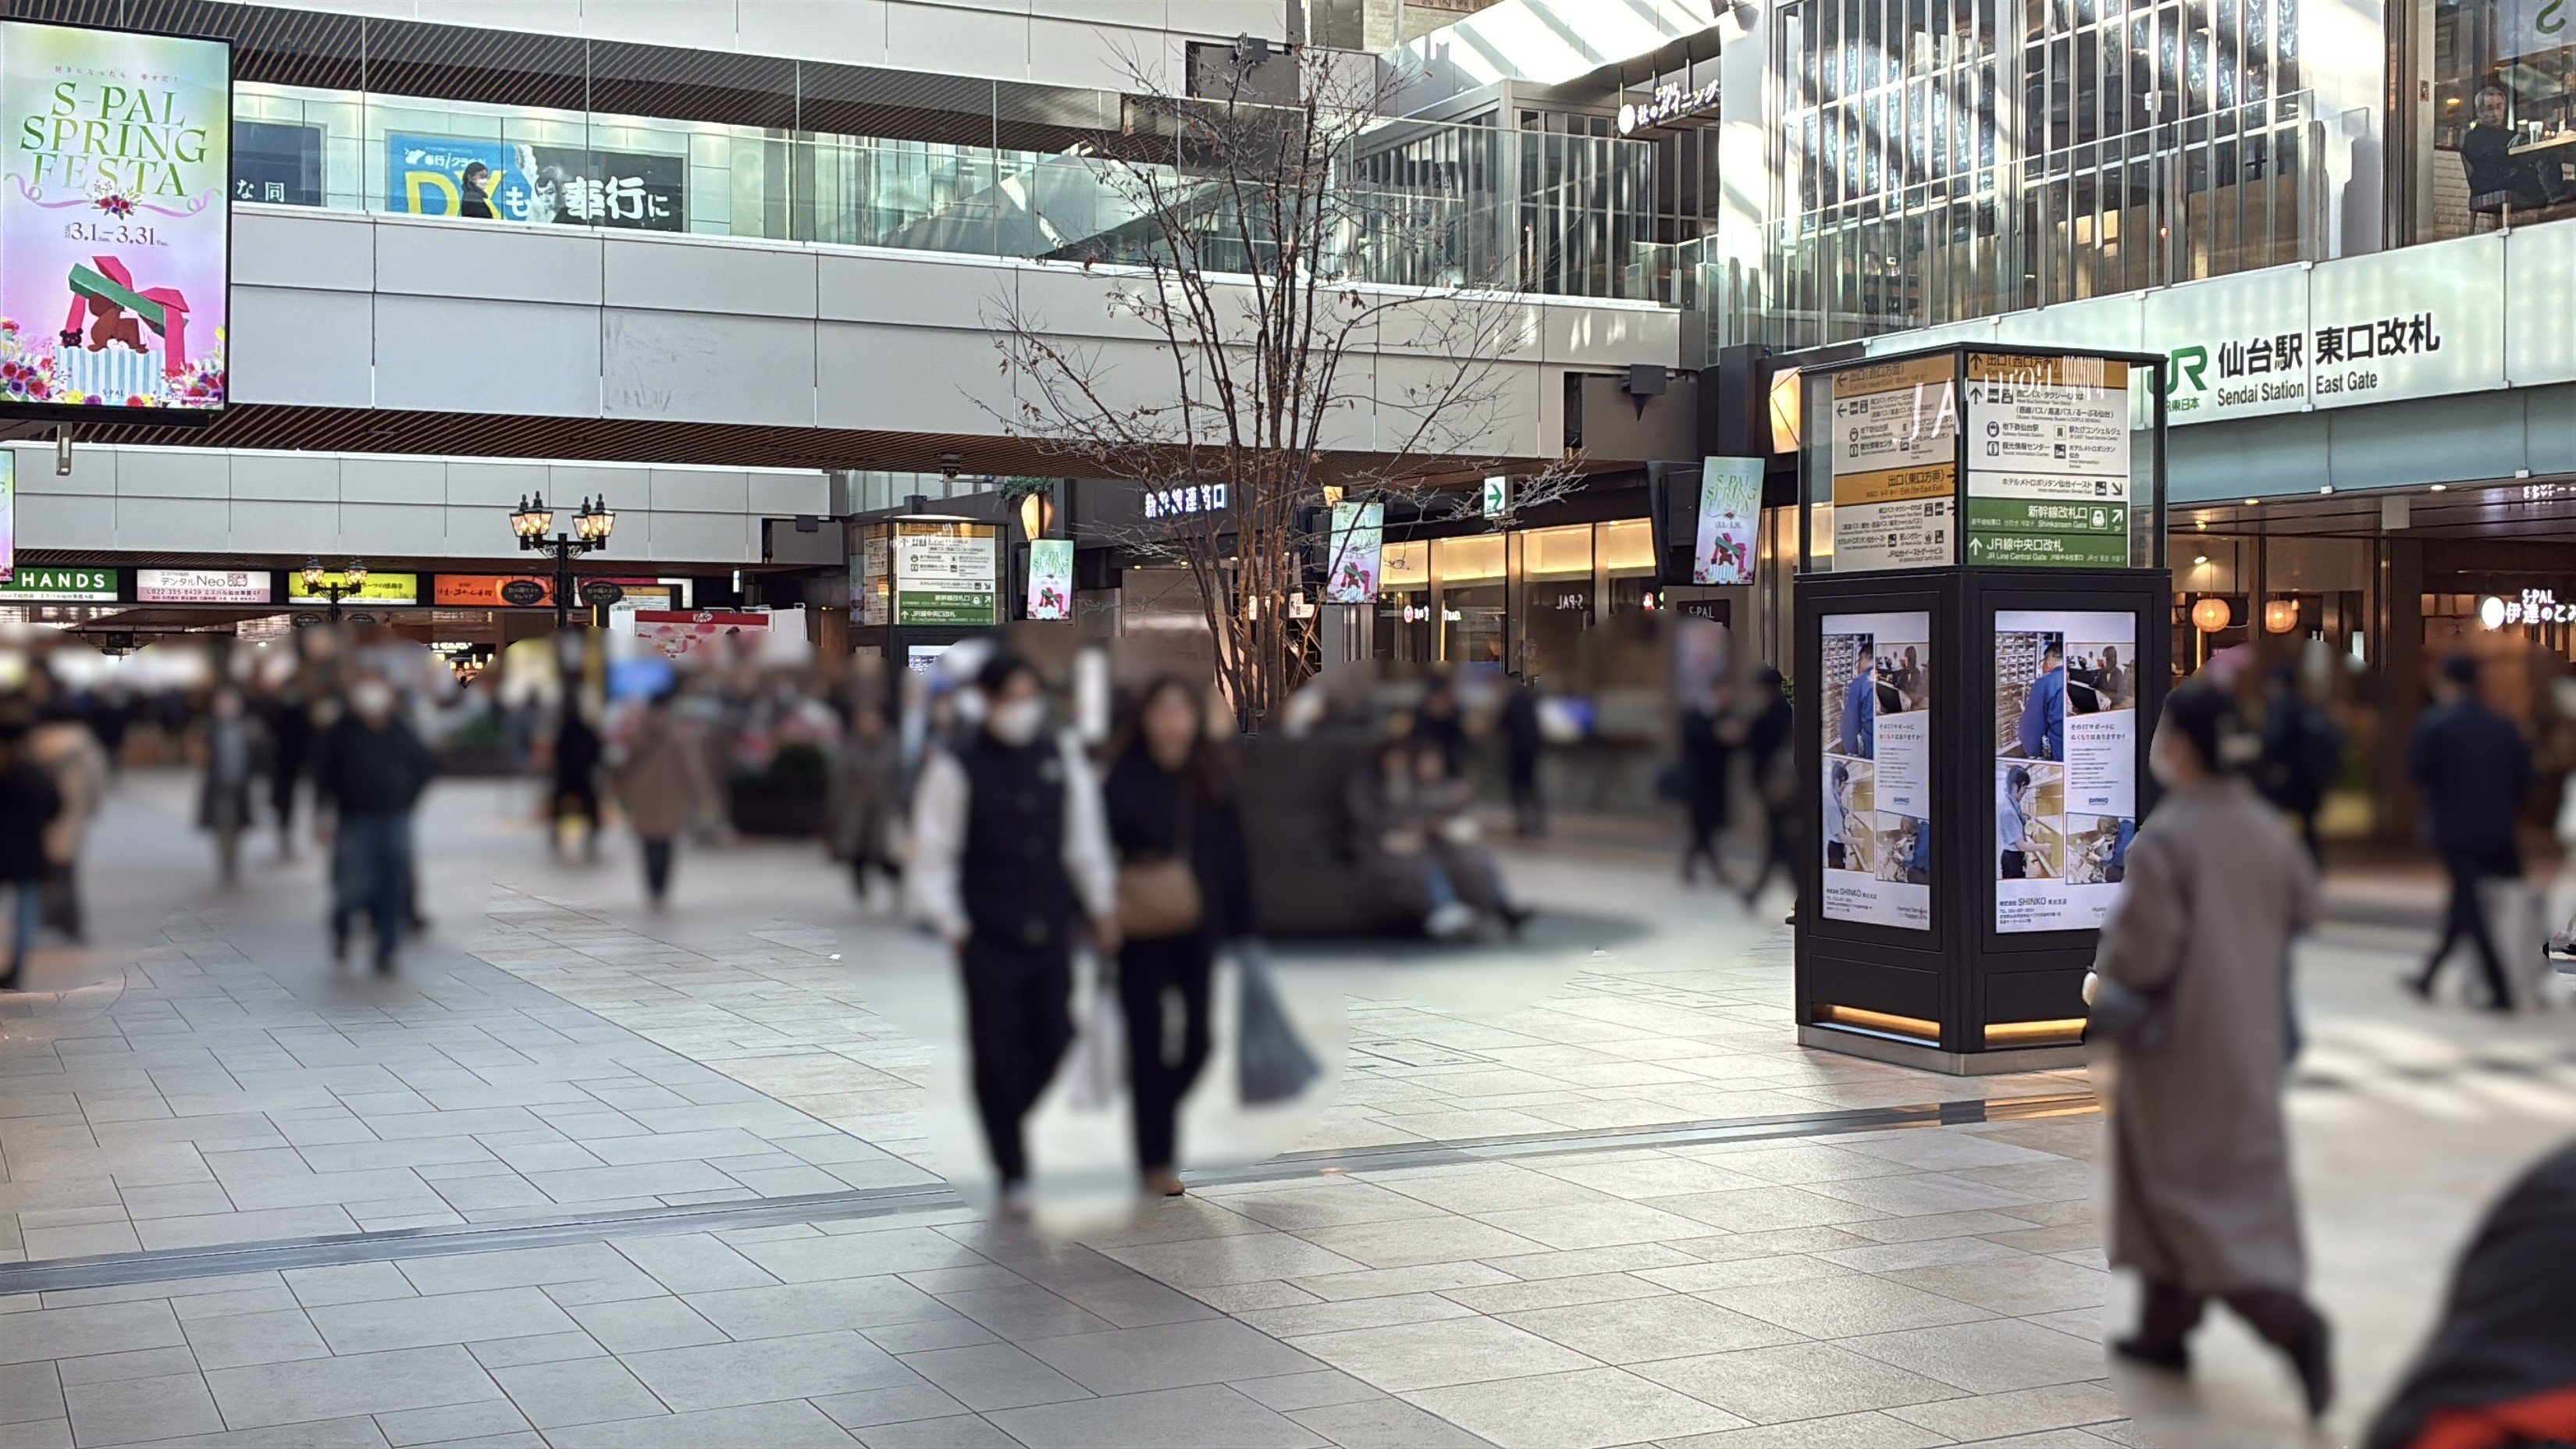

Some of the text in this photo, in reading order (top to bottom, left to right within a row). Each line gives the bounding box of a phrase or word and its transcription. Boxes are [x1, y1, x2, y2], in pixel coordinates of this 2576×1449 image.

[51, 82, 187, 128] S-PAL
[20, 115, 208, 163] SPRING
[32, 152, 188, 198] FESTA
[564, 176, 670, 219] 奉行に
[2218, 312, 2441, 379] 仙台駅 東口改札
[2147, 345, 2208, 395] JR
[2218, 371, 2379, 407] Sendai Station East Gate
[2166, 397, 2201, 413] R東日本
[1888, 468, 1944, 487] 出口(東口方面)
[2027, 504, 2088, 520] 新幹線改札口
[2038, 520, 2073, 529] Shinkansen
[2073, 521, 2088, 529] Gate
[1986, 537, 2064, 553] JR線中央口改札
[22, 571, 105, 589] HANDS
[161, 575, 226, 587] デンタルNeo
[2522, 589, 2556, 605] S-PAL
[1688, 606, 1715, 618] S-PAL
[2018, 897, 2047, 906] SHINKO
